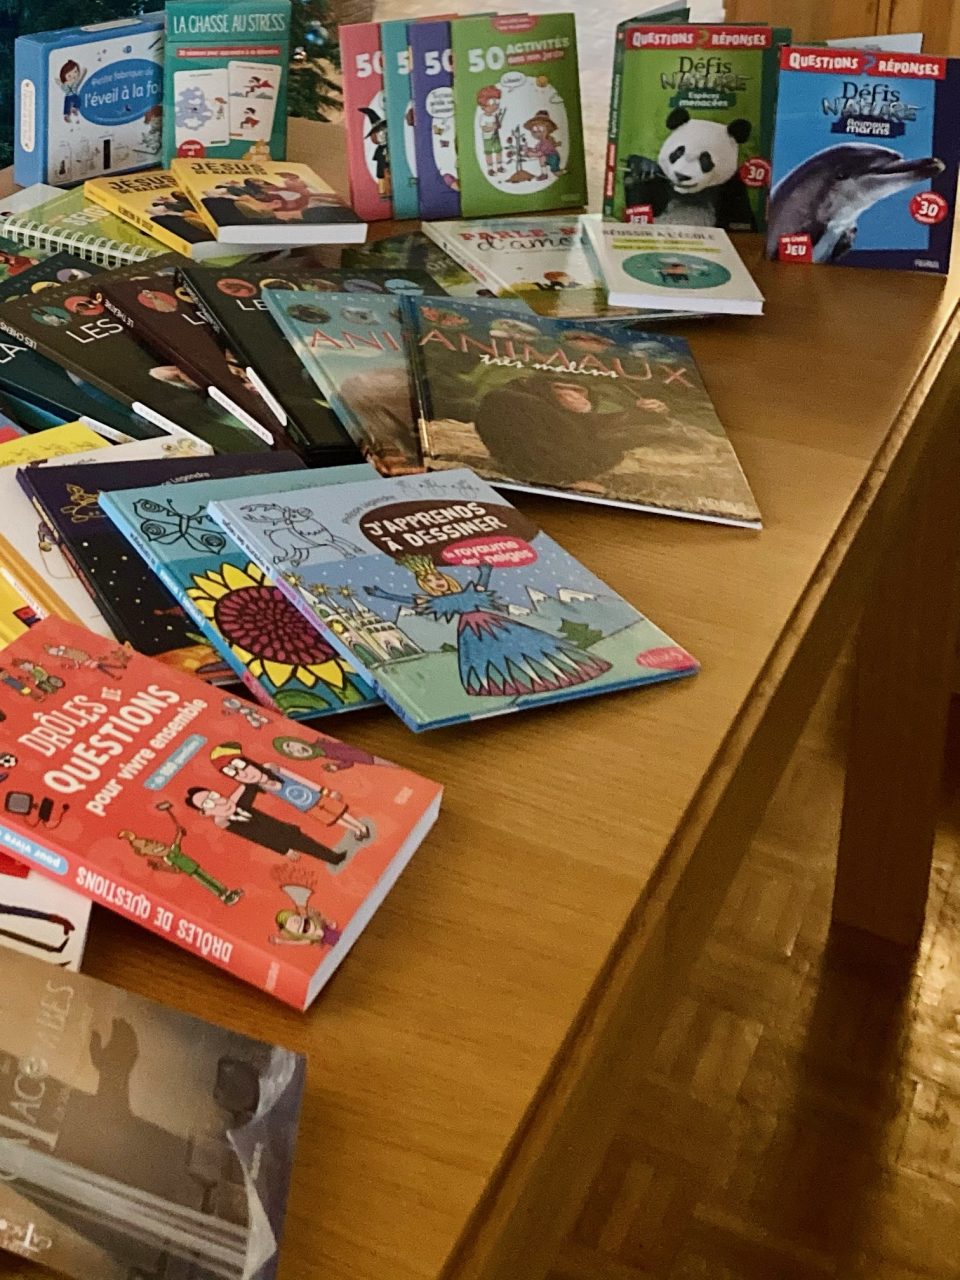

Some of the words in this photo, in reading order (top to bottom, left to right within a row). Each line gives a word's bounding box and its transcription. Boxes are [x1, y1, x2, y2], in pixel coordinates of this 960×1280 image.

[173, 15, 187, 34] LA
[188, 14, 229, 33] CHASSE
[231, 14, 247, 33] AU
[248, 13, 286, 32] STRESS
[632, 31, 694, 47] QUESTIONS
[711, 31, 767, 47] RÉPONSES
[467, 44, 505, 73] 50
[505, 34, 570, 55] ACTIVITÉS
[678, 55, 732, 76] Défis
[789, 52, 858, 69] QUESTIONS
[878, 59, 940, 76] RÉPONSES
[660, 70, 753, 93] NATURE
[842, 81, 901, 105] Défis
[84, 86, 119, 108] l'éveil
[121, 85, 130, 100] à
[132, 83, 143, 98] la
[822, 95, 927, 122] NATURE
[845, 125, 890, 136] marins
[191, 161, 265, 172] JÉSUS
[748, 165, 765, 180] 30
[108, 174, 177, 191] JÉSUS
[919, 199, 939, 217] 30
[784, 244, 807, 256] JEU
[65, 317, 124, 344] LES
[24, 336, 38, 351] LES
[418, 328, 697, 389] ANIMAUX
[479, 353, 524, 369] très
[533, 359, 620, 379] malins
[363, 501, 488, 536] J'APPRENDS
[402, 515, 509, 548] DESSINER
[453, 539, 520, 558] royaume
[483, 549, 534, 565] neiges
[16, 694, 109, 758] DRÔLES
[43, 684, 181, 794] QUESTIONS
[85, 777, 124, 817] pour
[117, 747, 157, 781] vivre
[149, 698, 209, 750] ensemble
[1, 830, 31, 858] vivre
[32, 846, 62, 871] pour
[74, 865, 152, 921] QUESTIONS
[153, 906, 173, 931] DE
[177, 919, 233, 964] DRÔLES
